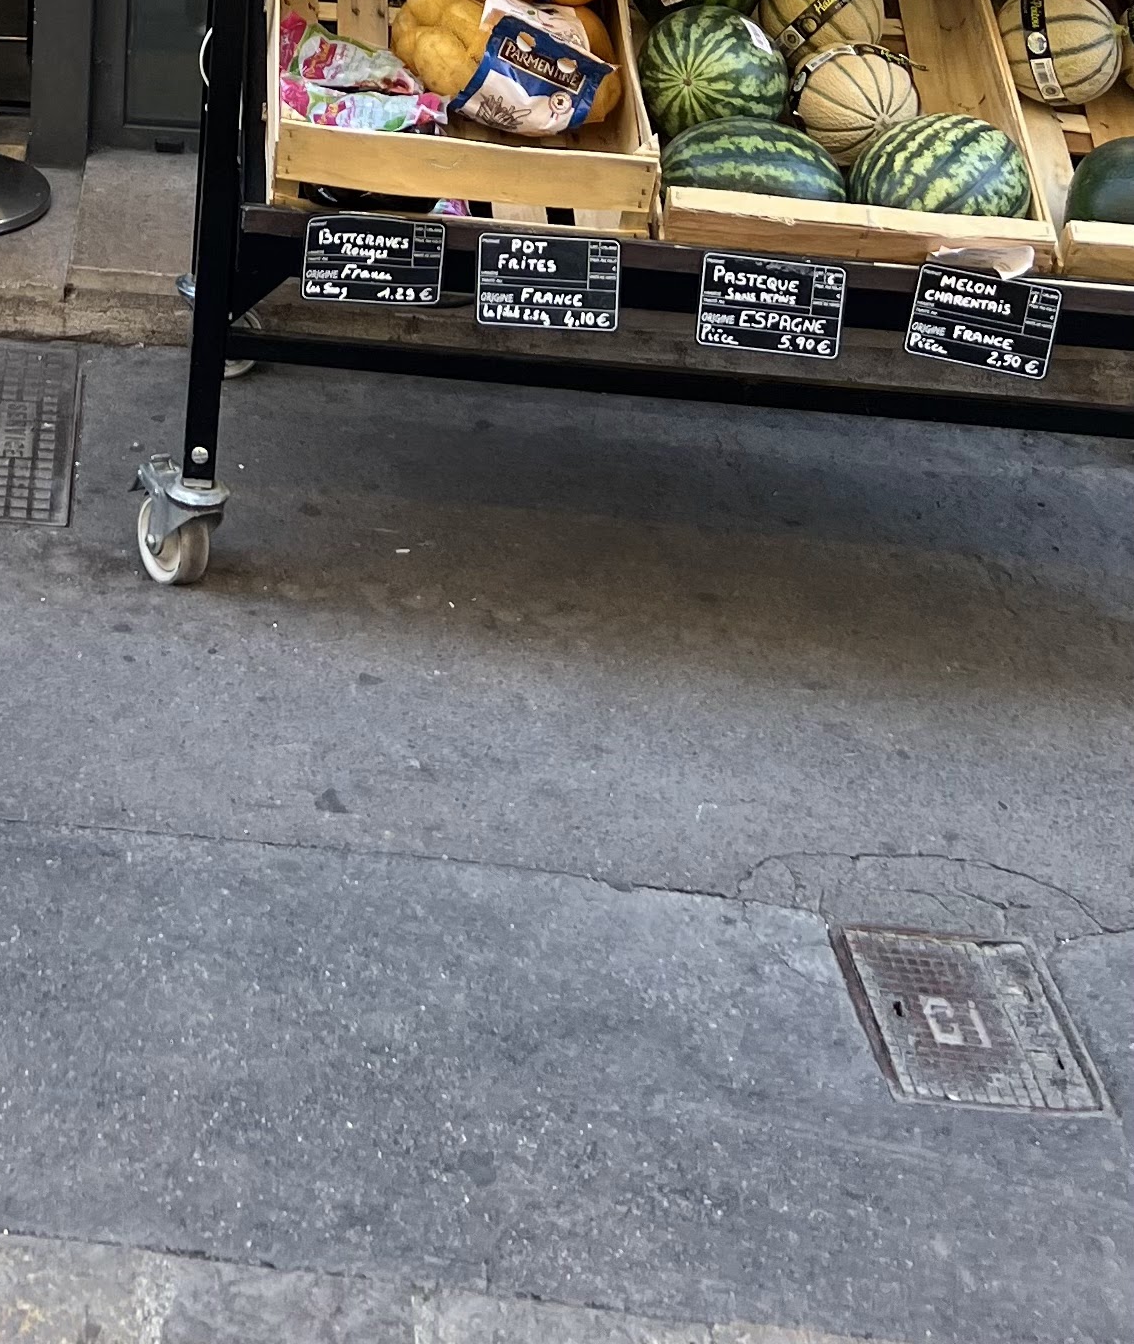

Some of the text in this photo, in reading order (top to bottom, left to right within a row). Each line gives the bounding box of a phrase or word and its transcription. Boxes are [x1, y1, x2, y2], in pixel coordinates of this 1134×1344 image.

[318, 227, 410, 250] BETTERAVES
[713, 265, 800, 294] PASTEQUE
[939, 274, 998, 297] MELON
[520, 287, 584, 308] FRANCE
[738, 310, 827, 334] ESPAGNE
[952, 324, 1015, 351] FRANCE
